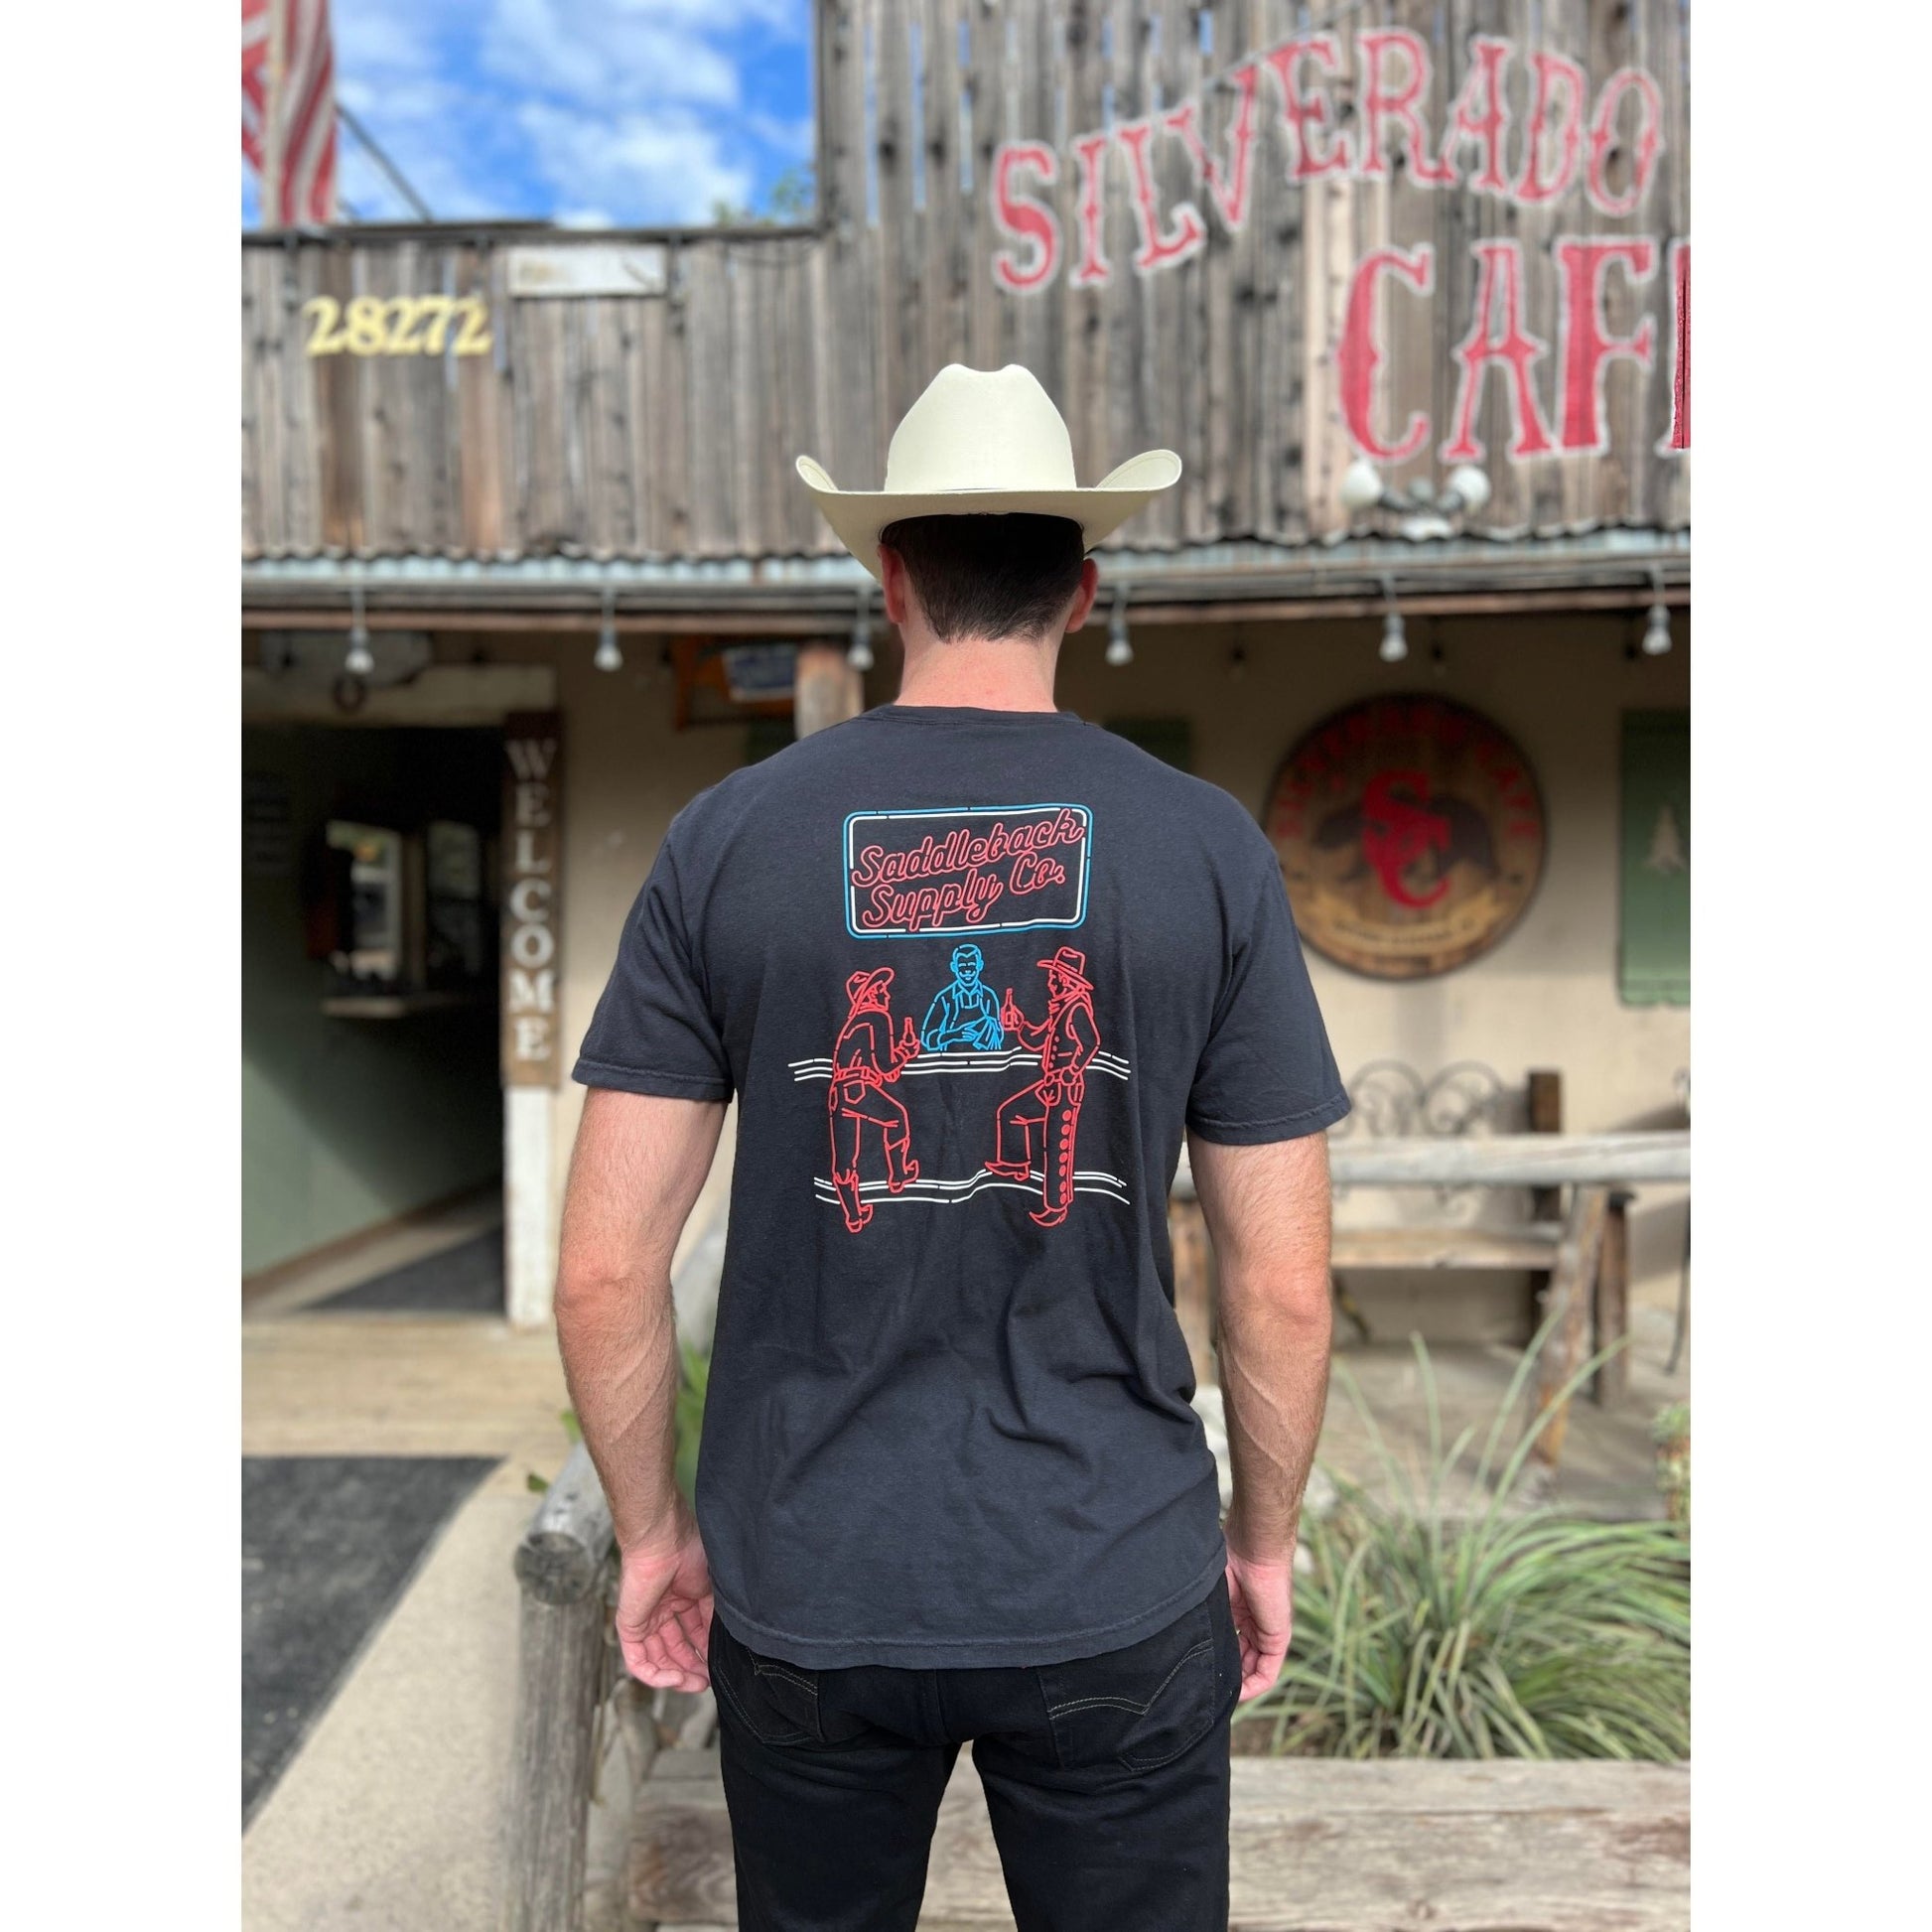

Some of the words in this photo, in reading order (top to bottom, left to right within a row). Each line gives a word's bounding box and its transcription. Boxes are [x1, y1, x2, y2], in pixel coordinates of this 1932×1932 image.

[994, 28, 1661, 292] SILVERADO
[304, 296, 492, 356] 28272
[1337, 237, 1691, 461] CAF
[505, 739, 556, 1061] WELCOME
[852, 808, 1085, 888] Saddleback
[862, 868, 1004, 932] Supply
[1009, 851, 1066, 896] Co.
